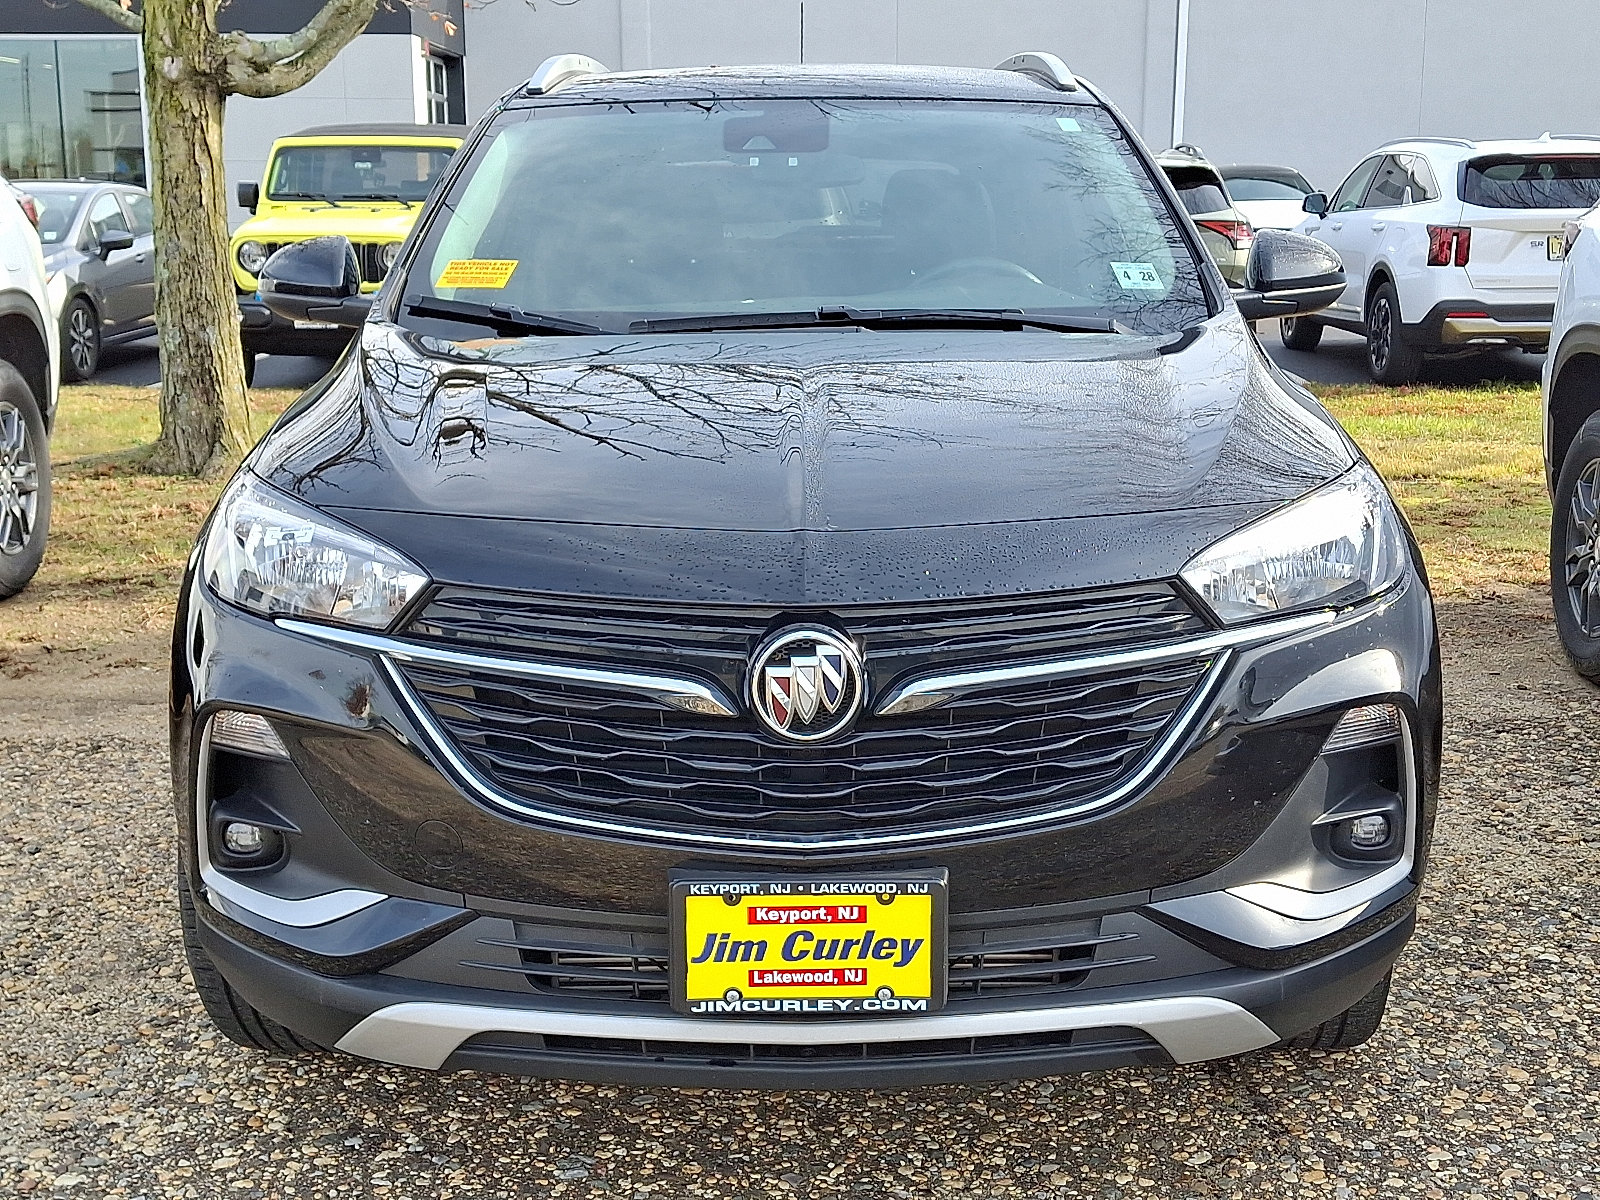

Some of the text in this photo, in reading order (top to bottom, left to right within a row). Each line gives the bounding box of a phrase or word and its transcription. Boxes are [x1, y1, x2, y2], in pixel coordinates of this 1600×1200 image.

[1123, 270, 1155, 281] 4 28
[690, 883, 928, 895] KEYPORT, NJ LAKEWOOD, NJ
[756, 906, 859, 924] Keyport, NJ
[691, 929, 924, 968] Jim Curley
[753, 969, 863, 985] Lakewood, NJ
[691, 999, 927, 1012] JIMCURLEY.COM
